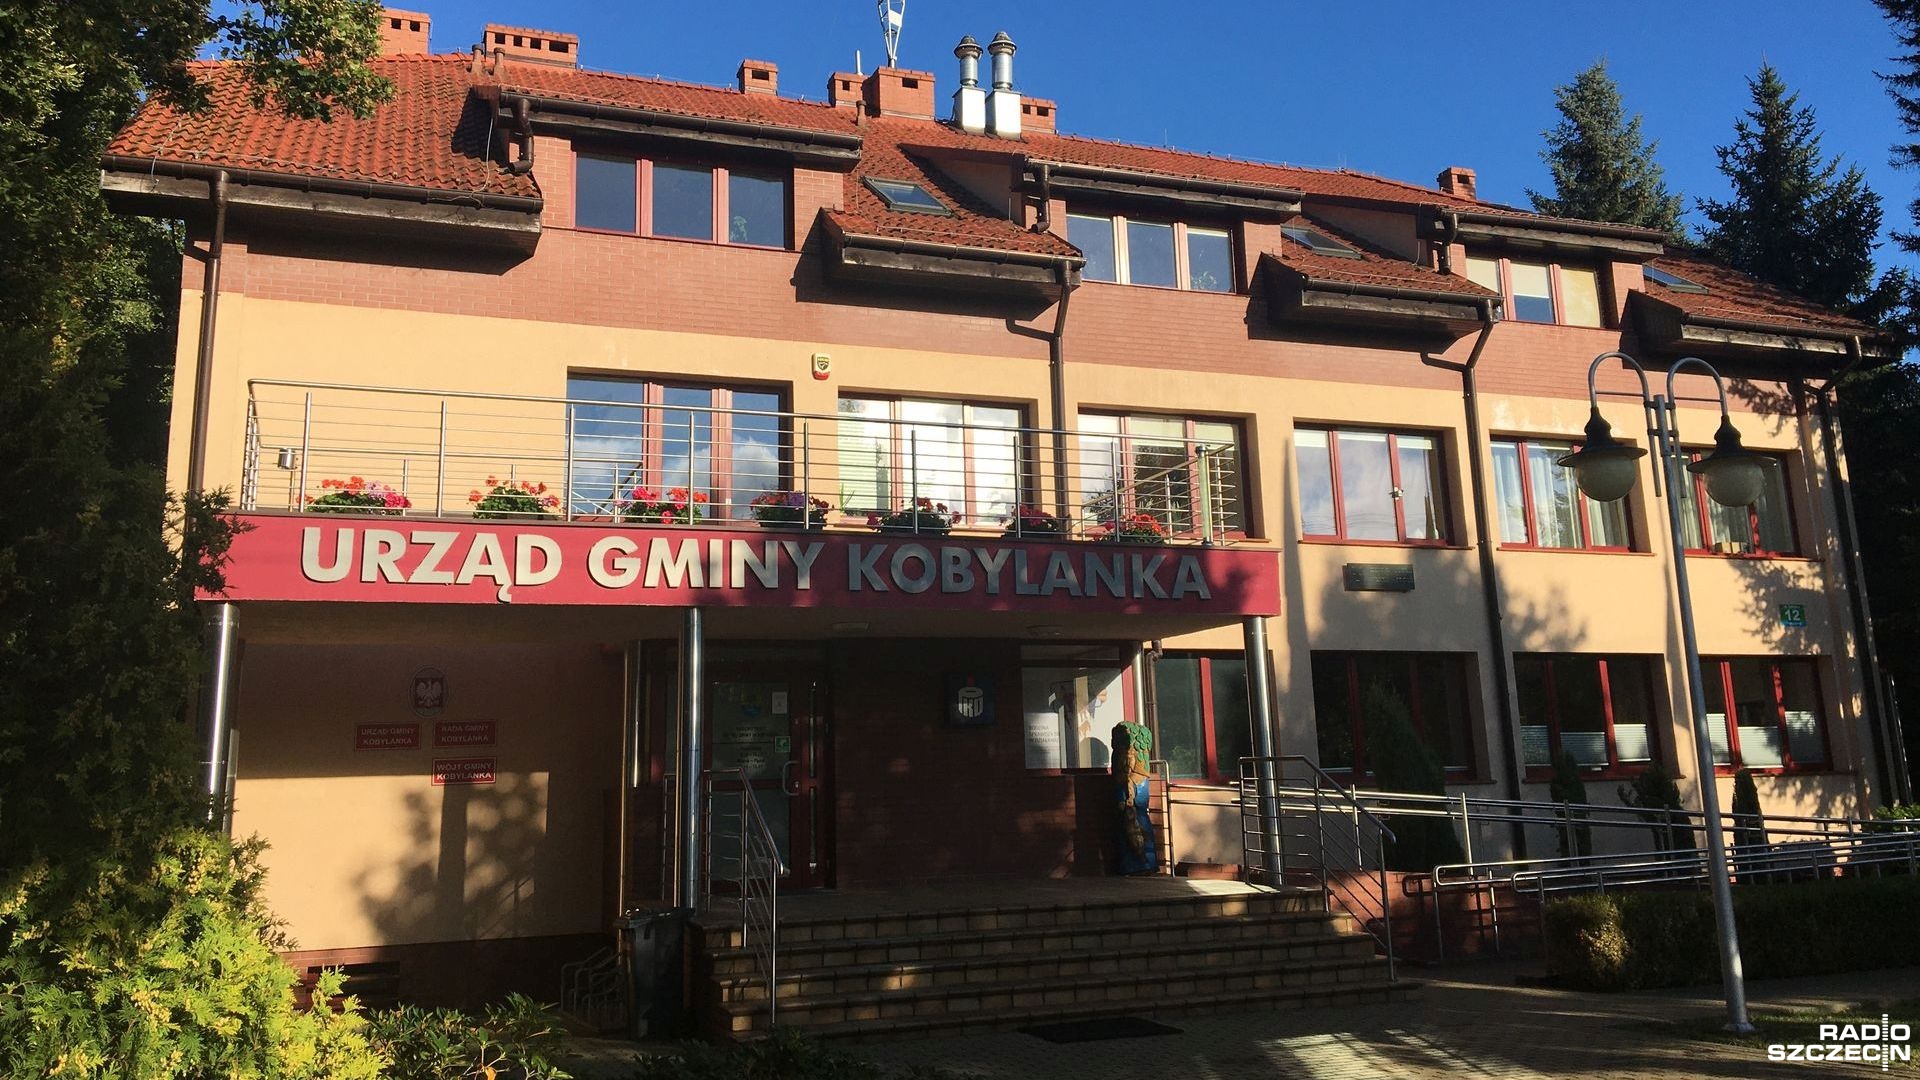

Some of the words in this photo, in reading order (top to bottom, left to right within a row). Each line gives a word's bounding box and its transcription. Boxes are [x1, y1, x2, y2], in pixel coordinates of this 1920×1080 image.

[300, 526, 562, 603] URZĄD
[587, 534, 826, 590] GMINY
[847, 542, 1212, 600] KOBYLANKA
[1784, 609, 1801, 621] 12
[436, 771, 493, 781] KOBYLANKA
